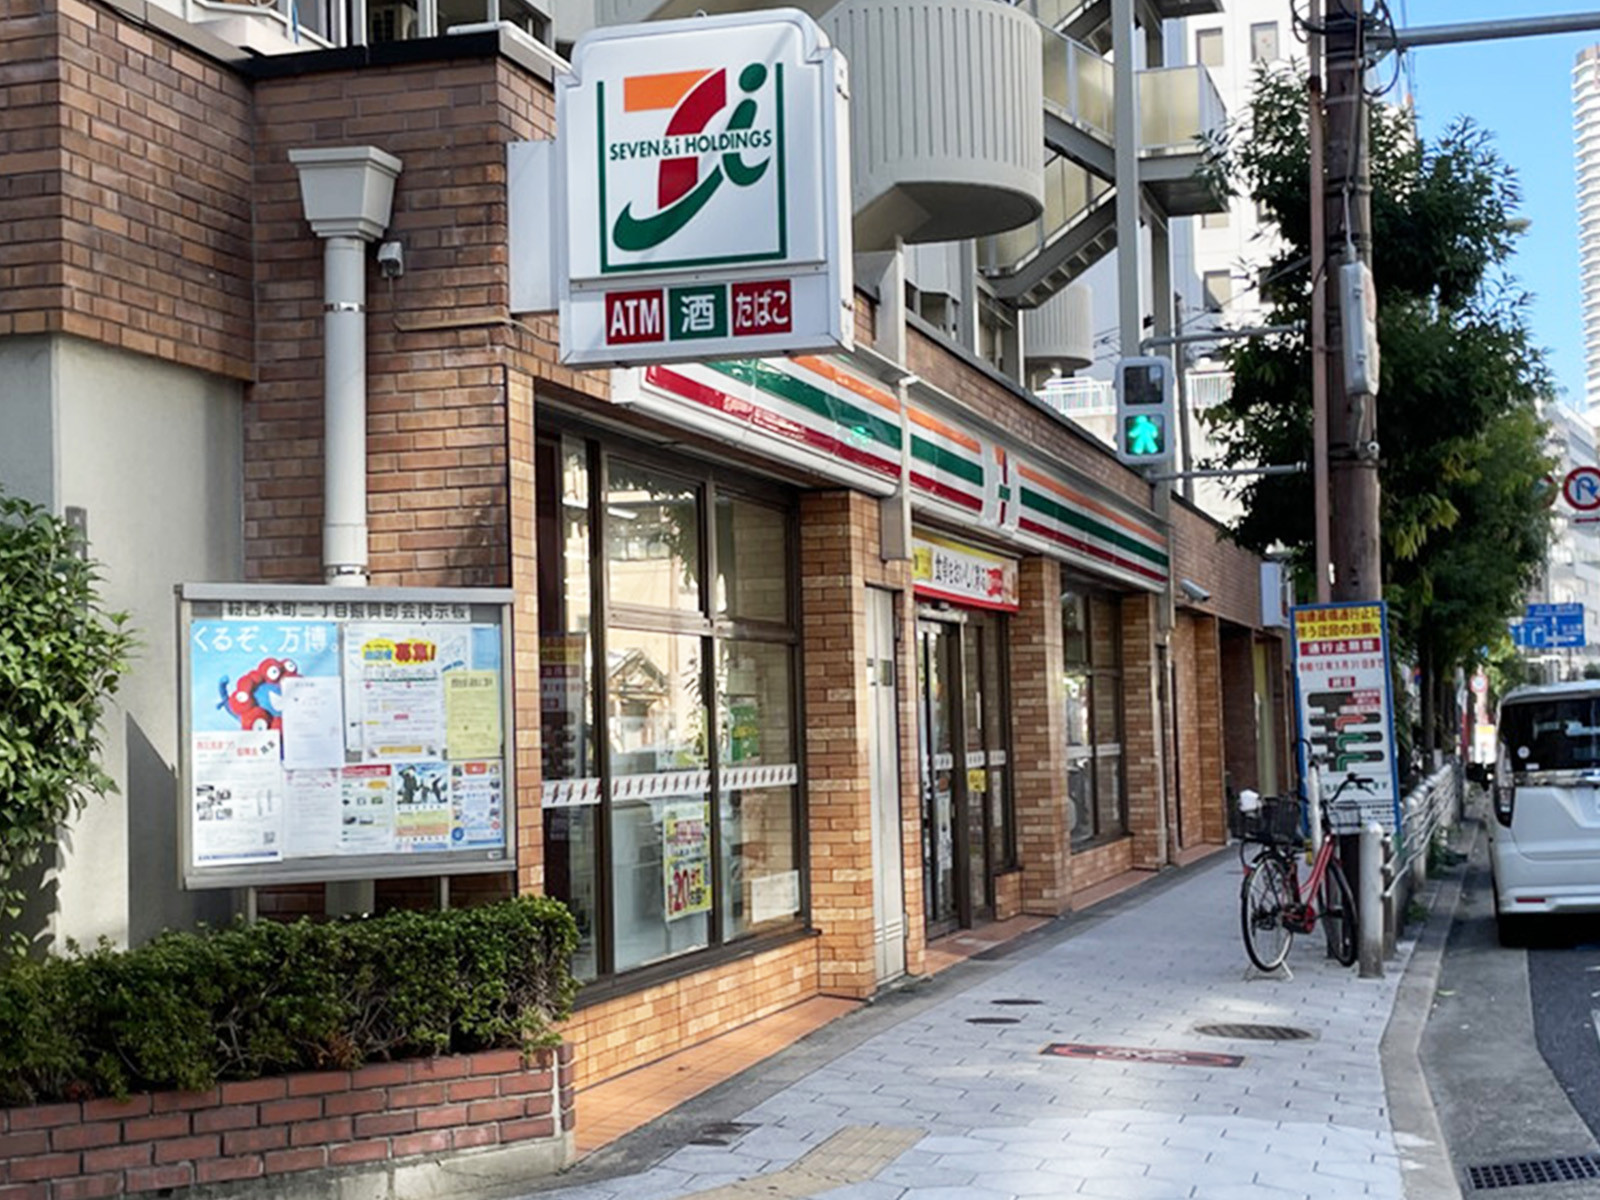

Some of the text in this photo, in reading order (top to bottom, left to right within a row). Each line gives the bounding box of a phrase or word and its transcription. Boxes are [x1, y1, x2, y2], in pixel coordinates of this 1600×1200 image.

[684, 130, 772, 154] HOLDINGS
[610, 298, 661, 337] ATM
[682, 294, 715, 333] 酒
[735, 289, 788, 329] たばこ
